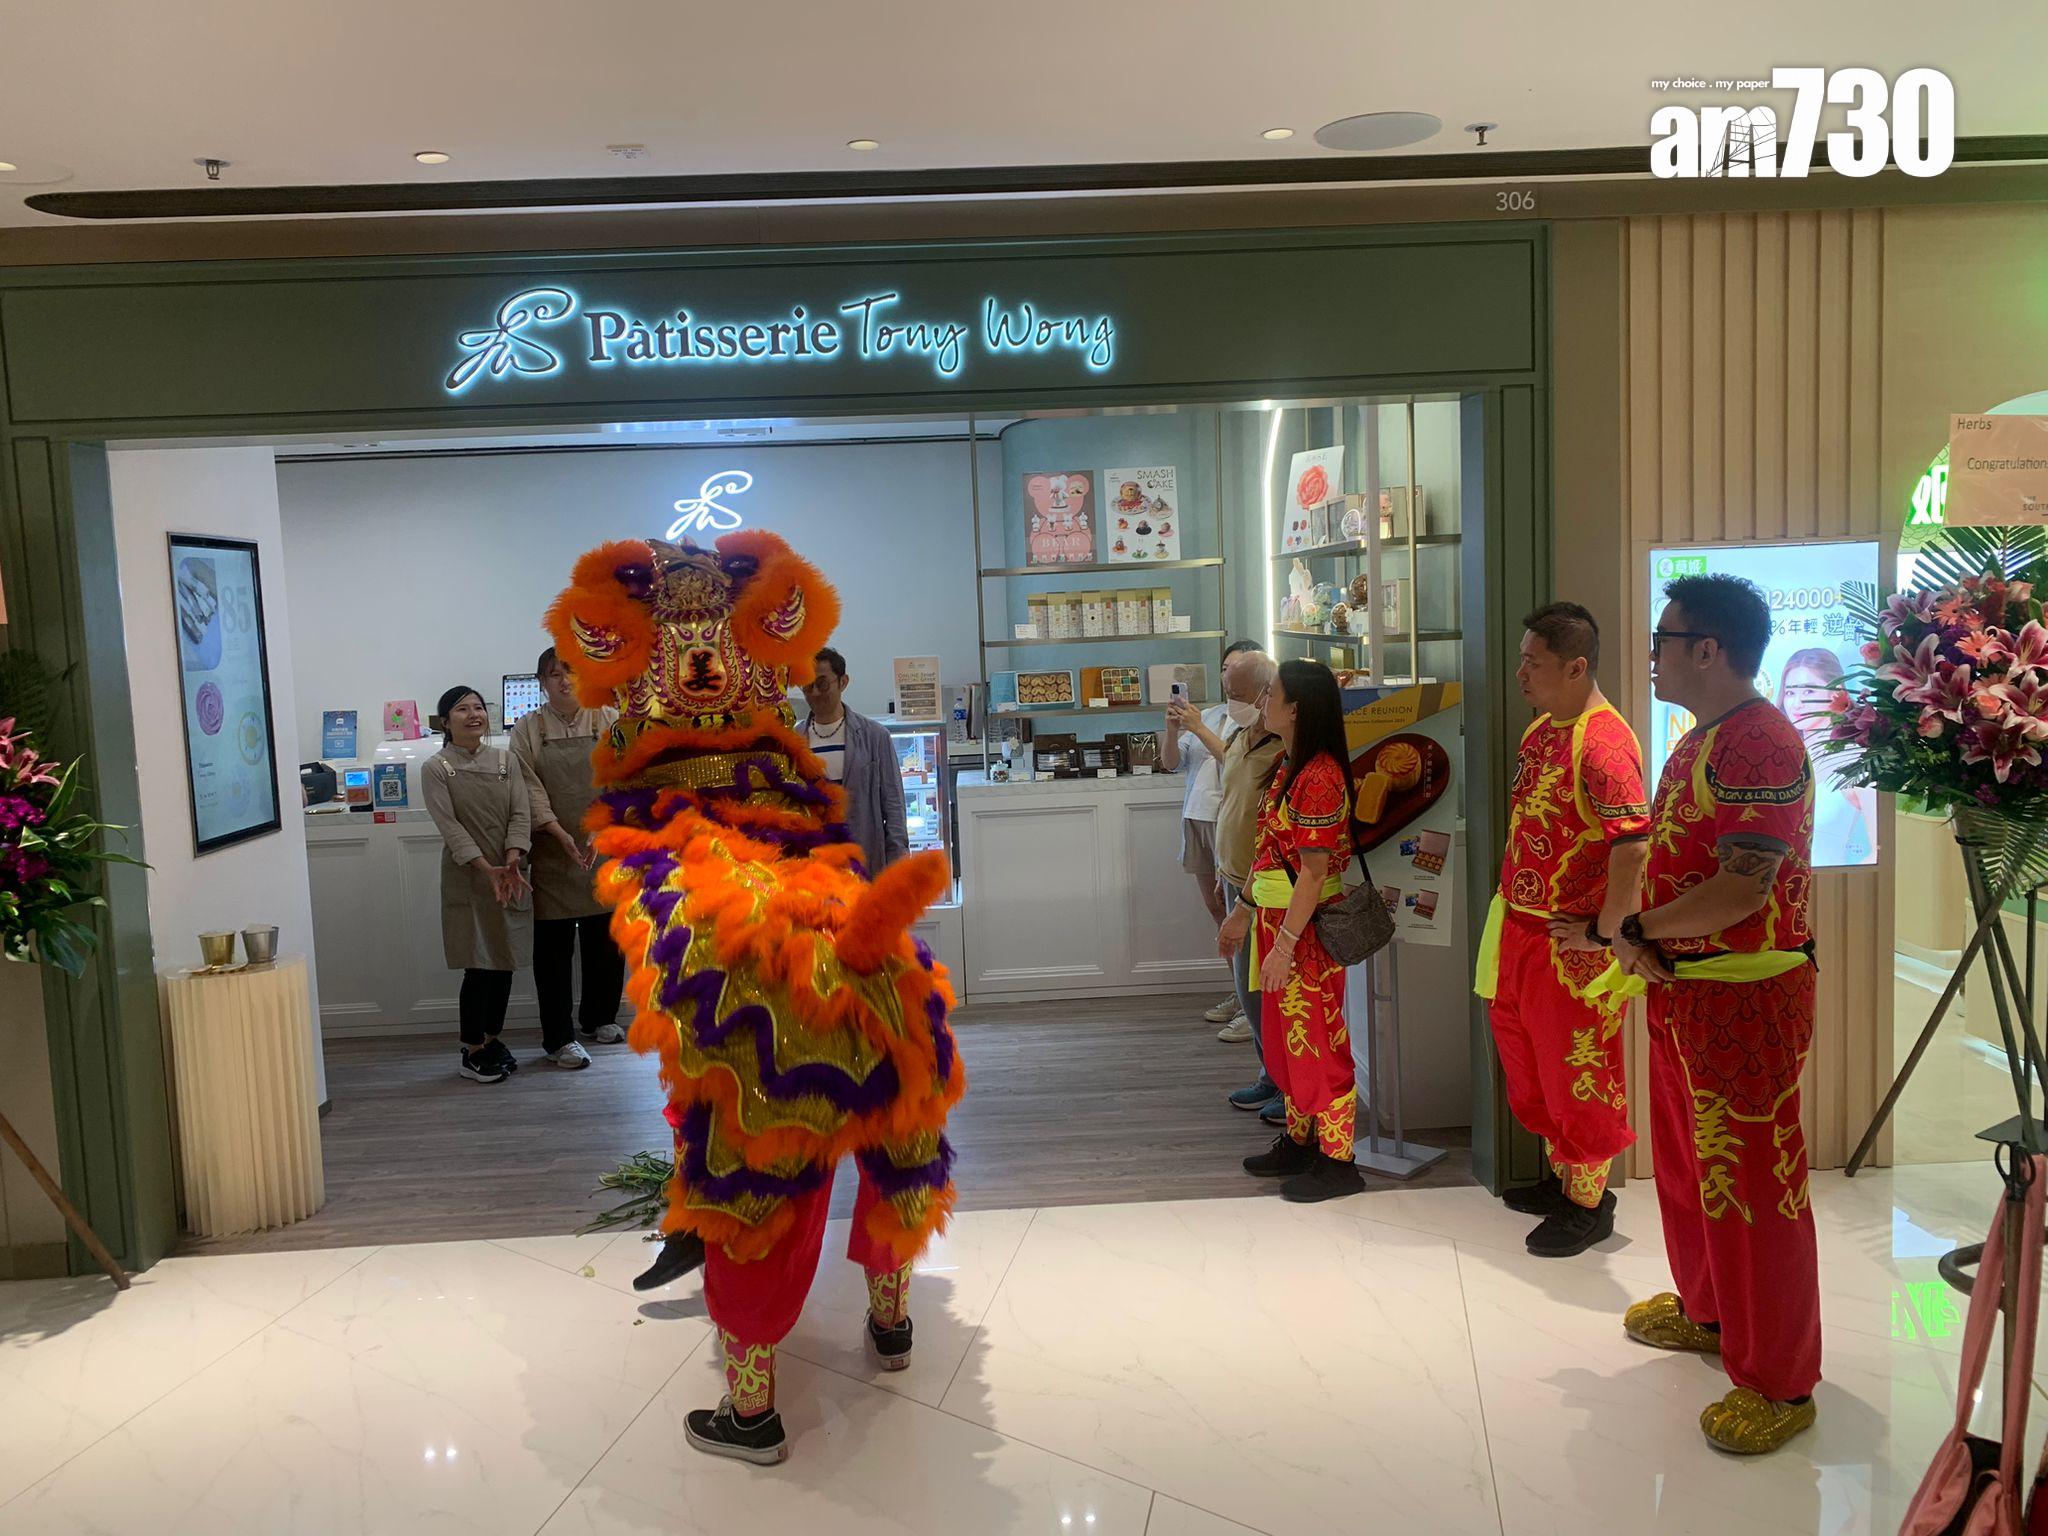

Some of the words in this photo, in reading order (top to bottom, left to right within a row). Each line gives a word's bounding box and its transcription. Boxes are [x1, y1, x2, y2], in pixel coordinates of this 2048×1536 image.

[1496, 190, 1535, 211] 306
[841, 293, 967, 373] Tony
[987, 298, 1113, 366] Wong
[1957, 418, 1992, 430] Herbs
[1137, 469, 1174, 479] SMASH
[1371, 706, 1412, 715] REUNION
[1755, 790, 1777, 801] LION
